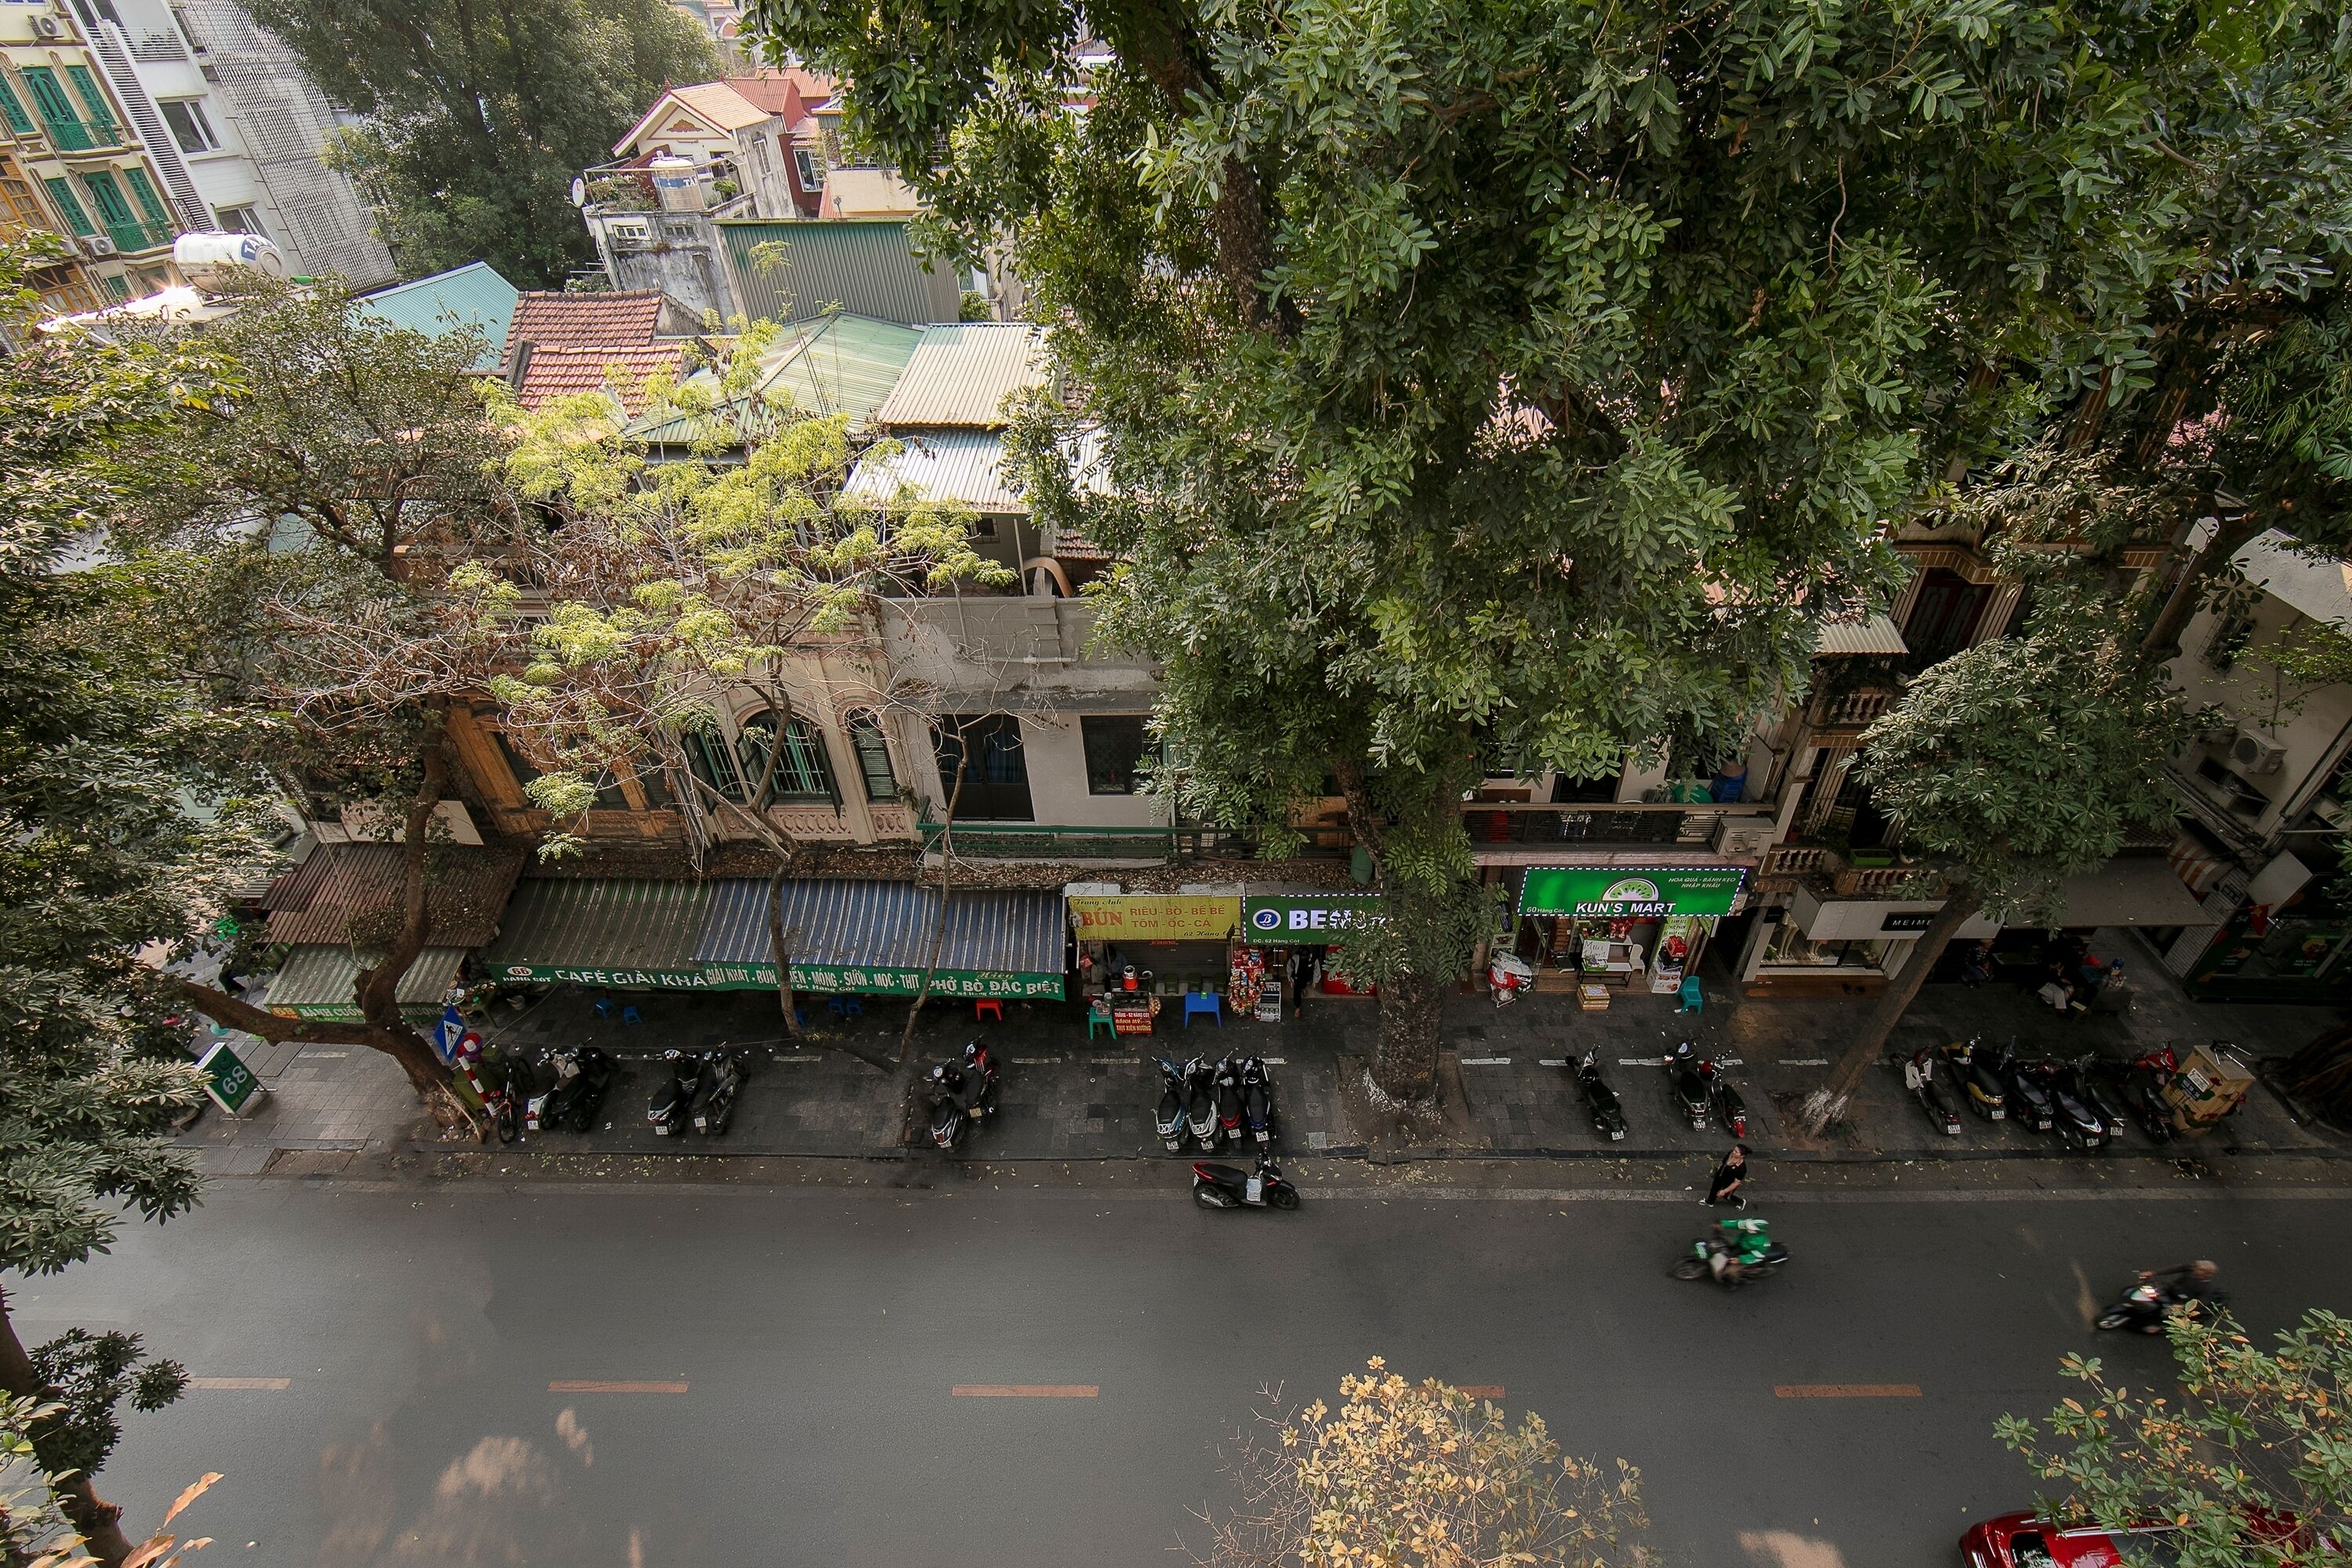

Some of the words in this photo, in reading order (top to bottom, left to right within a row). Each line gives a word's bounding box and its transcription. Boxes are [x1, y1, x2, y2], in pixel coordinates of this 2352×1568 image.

[1130, 906, 1157, 916] RIÊU
[1165, 906, 1182, 916] BÒ
[1576, 902, 1624, 913] KUN'S
[1630, 902, 1676, 913] MART
[1080, 908, 1123, 926] BÚN
[1131, 919, 1159, 927] TÔM
[756, 966, 778, 985] BÚN
[962, 978, 985, 992] BÒ
[989, 979, 1022, 995] ĐẶC
[1025, 980, 1061, 996] BIỆT
[223, 1065, 248, 1094] 68
